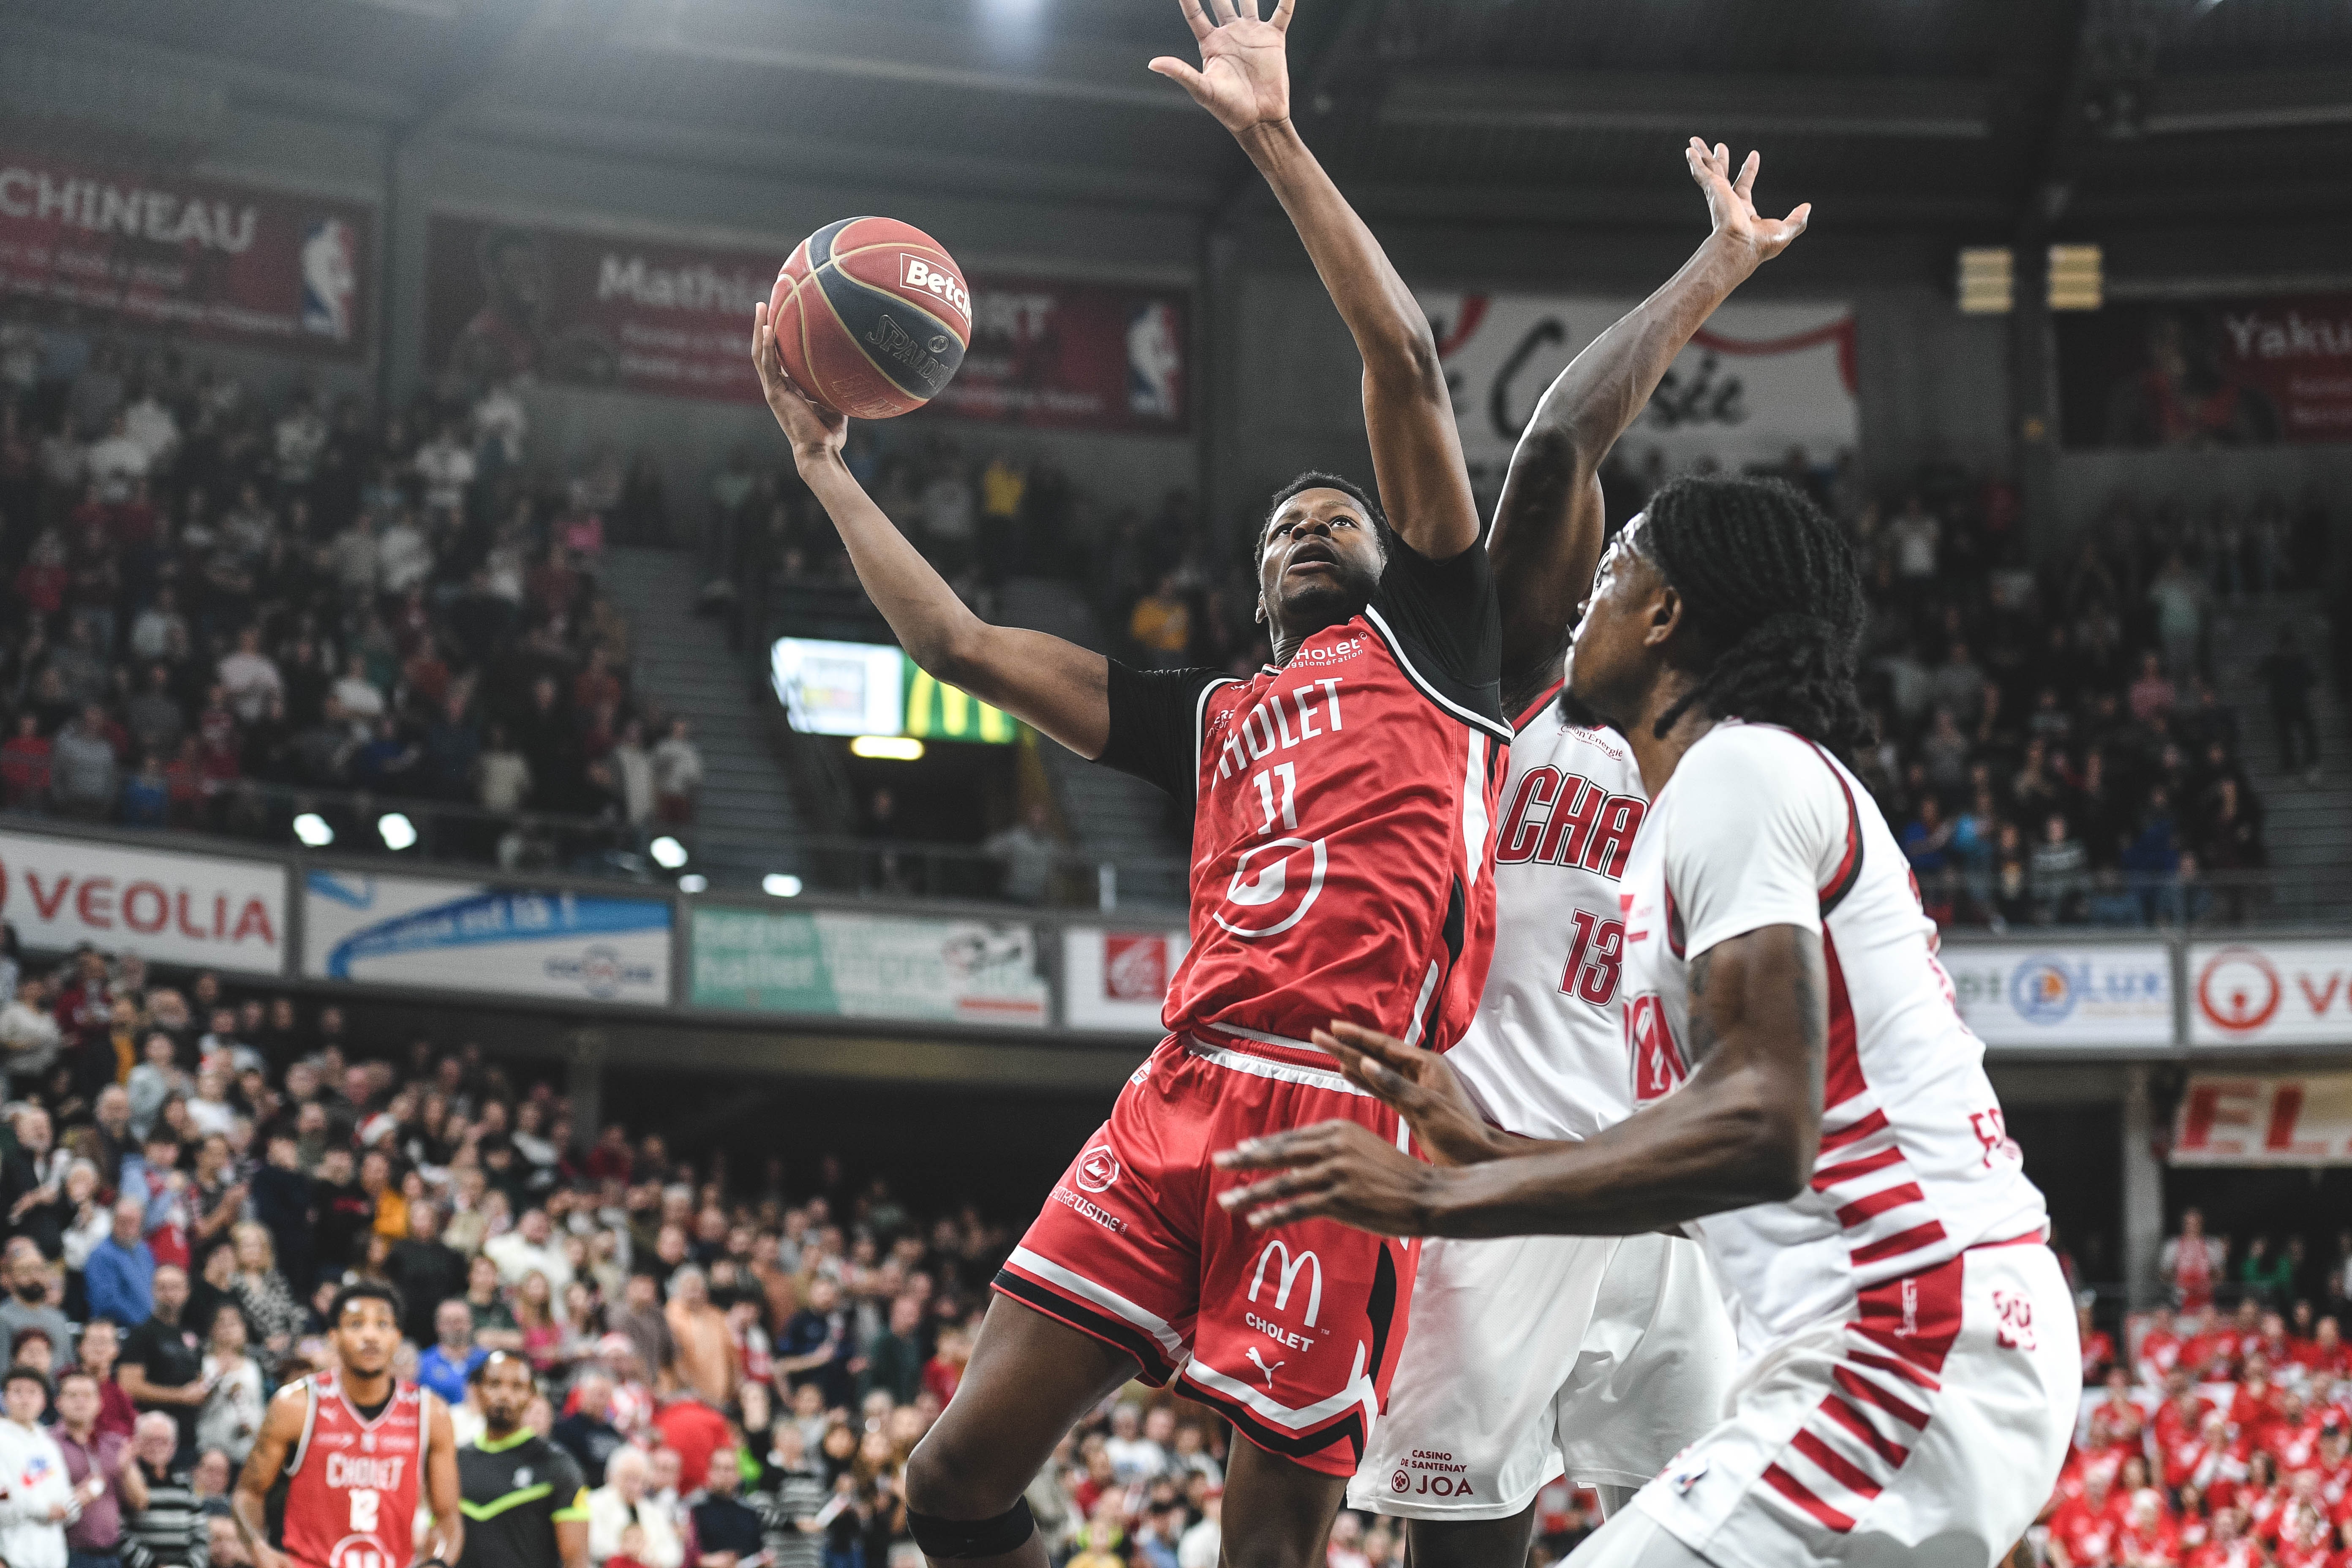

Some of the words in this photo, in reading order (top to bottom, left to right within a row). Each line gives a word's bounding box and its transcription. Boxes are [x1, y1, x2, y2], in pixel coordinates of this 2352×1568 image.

[1295, 638, 1361, 660] HOLet
[1211, 677, 1343, 791] HOLET
[1253, 761, 1298, 835] 11
[1495, 764, 1650, 882] CHA
[25, 869, 277, 945] VEOLIA
[1558, 908, 1625, 1006] 13
[2180, 1082, 2352, 1152] EL
[1246, 1312, 1314, 1352] CHOLET
[1400, 1458, 1409, 1467] DE
[1411, 1460, 1467, 1473] SANTENAY
[1412, 1449, 1452, 1461] CASINO
[1416, 1475, 1474, 1497] JOA
